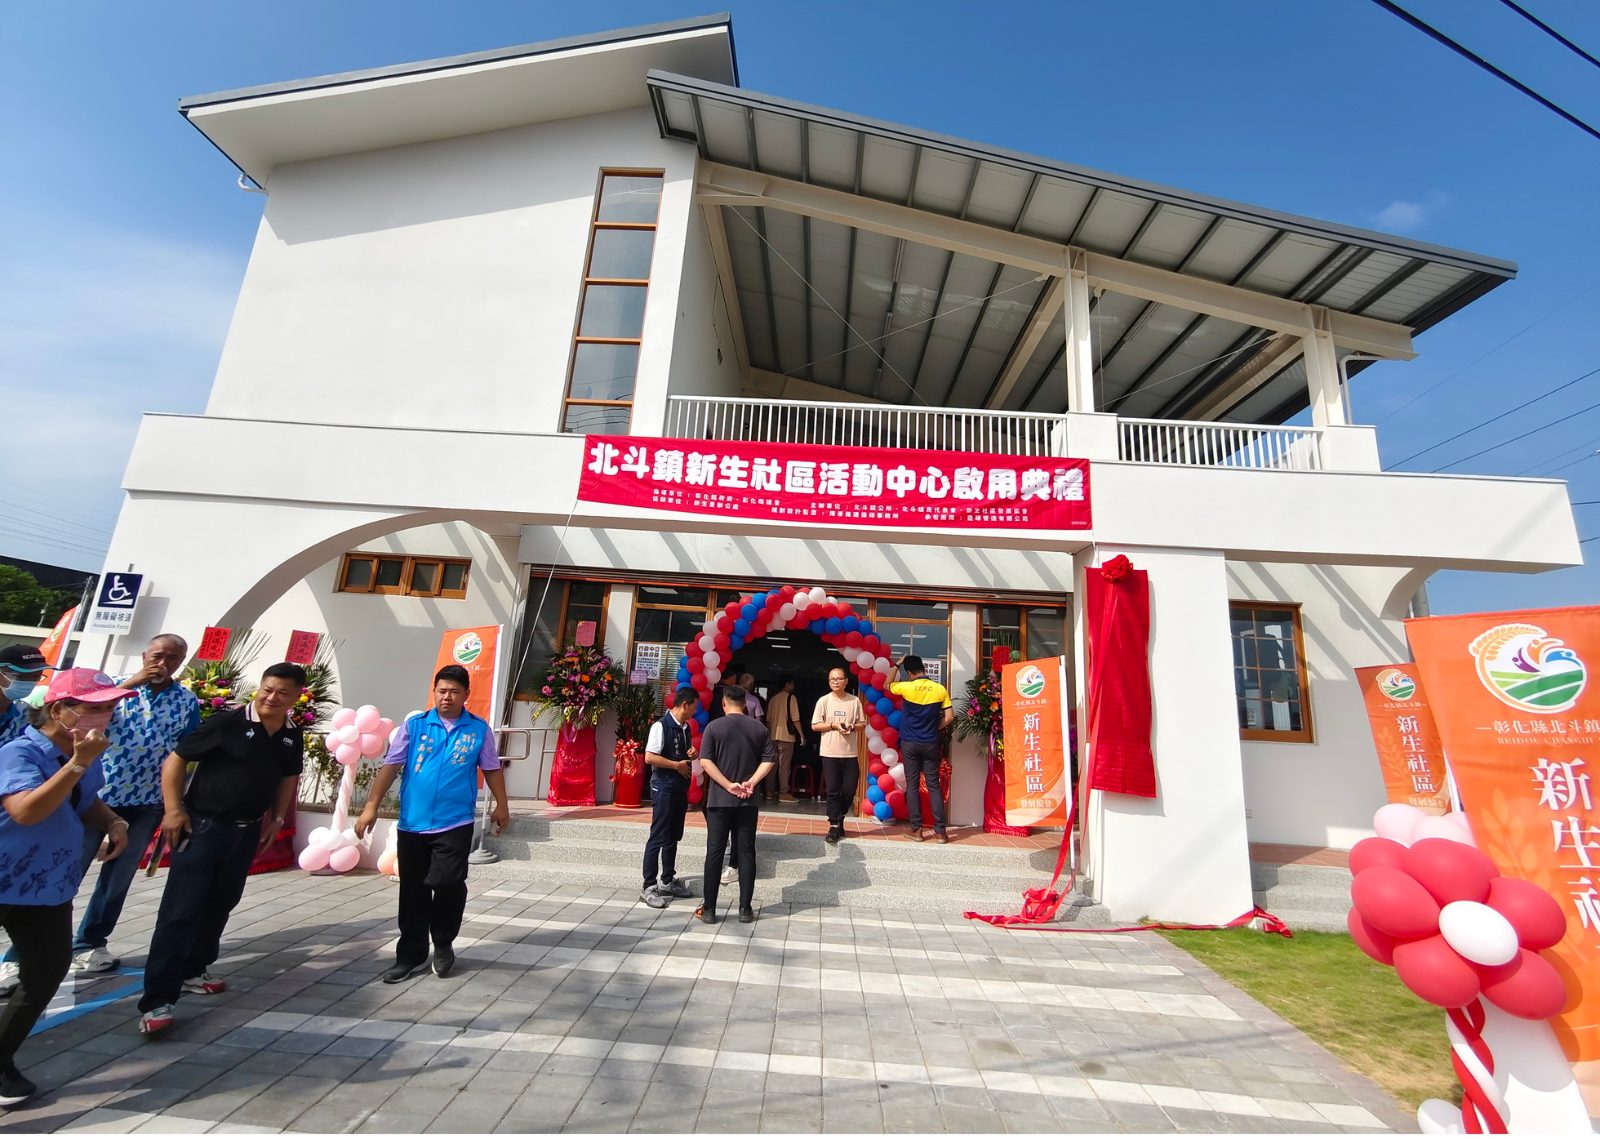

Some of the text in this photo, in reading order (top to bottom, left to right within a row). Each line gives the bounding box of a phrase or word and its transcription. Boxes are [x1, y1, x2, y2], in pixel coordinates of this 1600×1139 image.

[587, 442, 1085, 501] 北斗鎮新生社區活動中心啟用典禮
[1023, 712, 1045, 793] 新生社區
[1395, 714, 1436, 794] 新生社區
